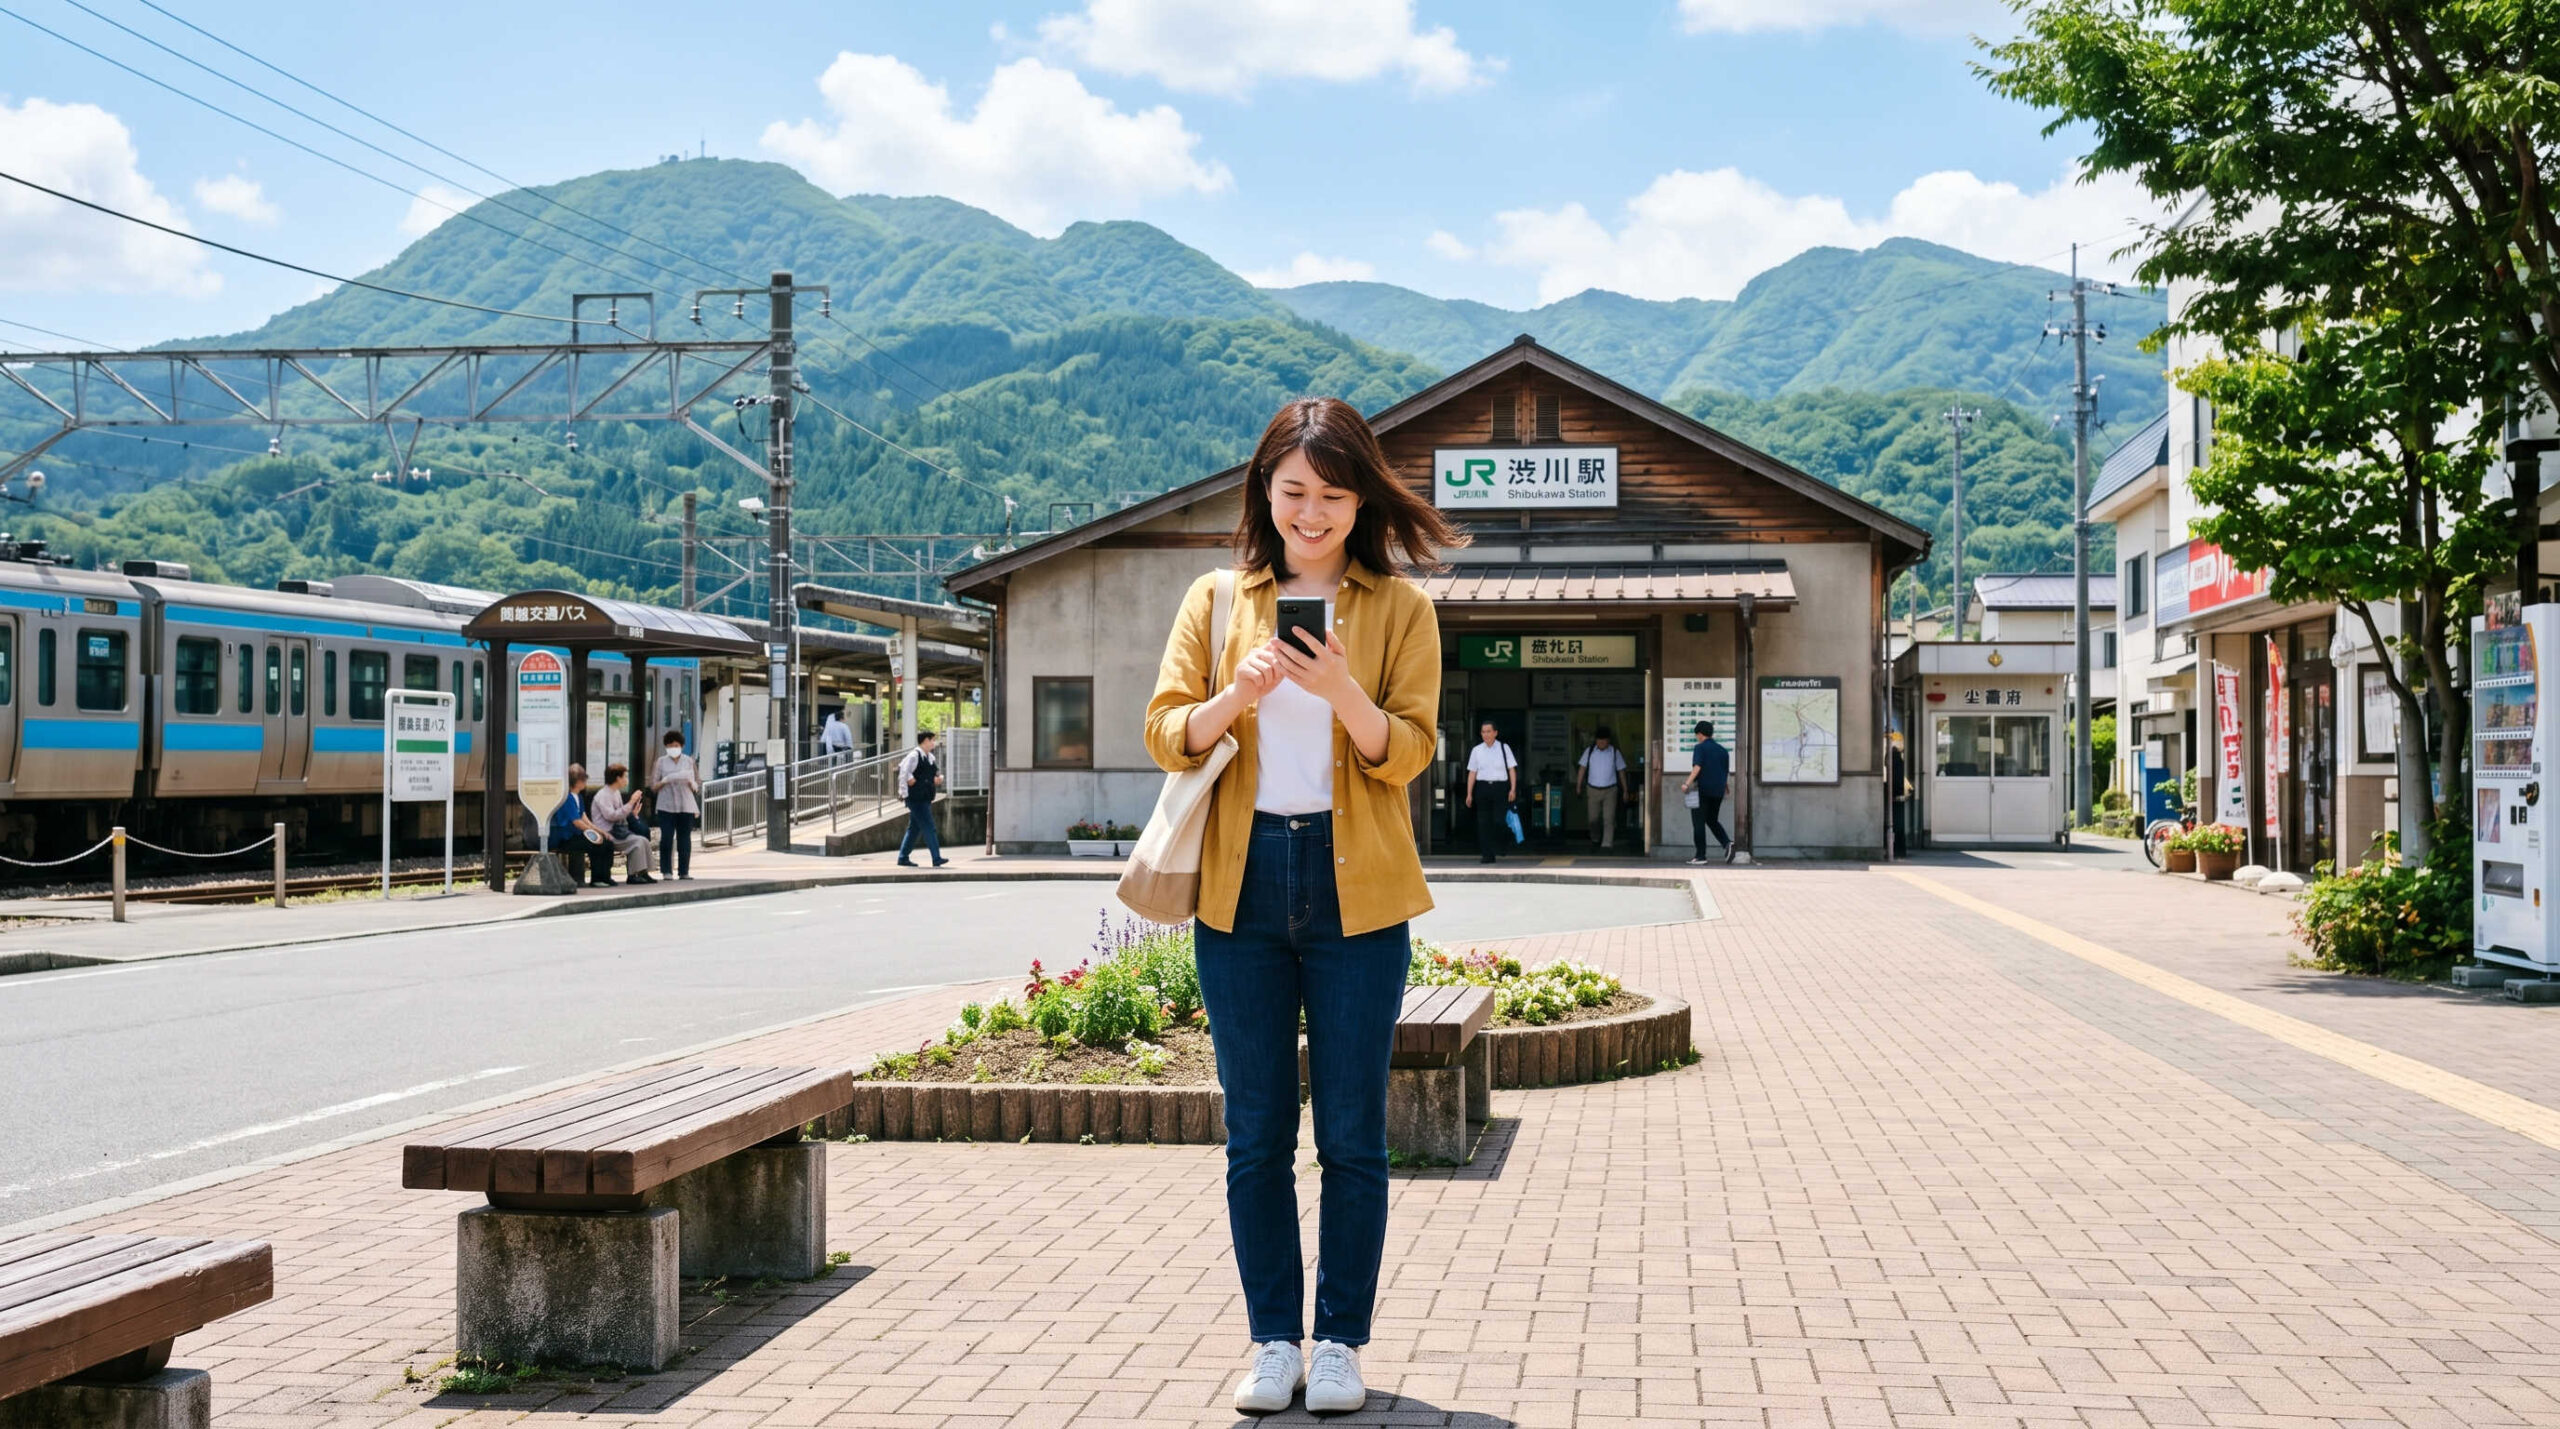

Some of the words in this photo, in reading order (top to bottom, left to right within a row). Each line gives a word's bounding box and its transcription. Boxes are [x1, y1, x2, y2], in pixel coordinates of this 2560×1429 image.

[1445, 459, 1497, 487] JR
[1508, 457, 1606, 485] 渋川駅
[1507, 489, 1565, 499] Shibukawa
[1568, 488, 1606, 499] Station
[1484, 640, 1513, 658] JR
[1578, 655, 1609, 664] Station
